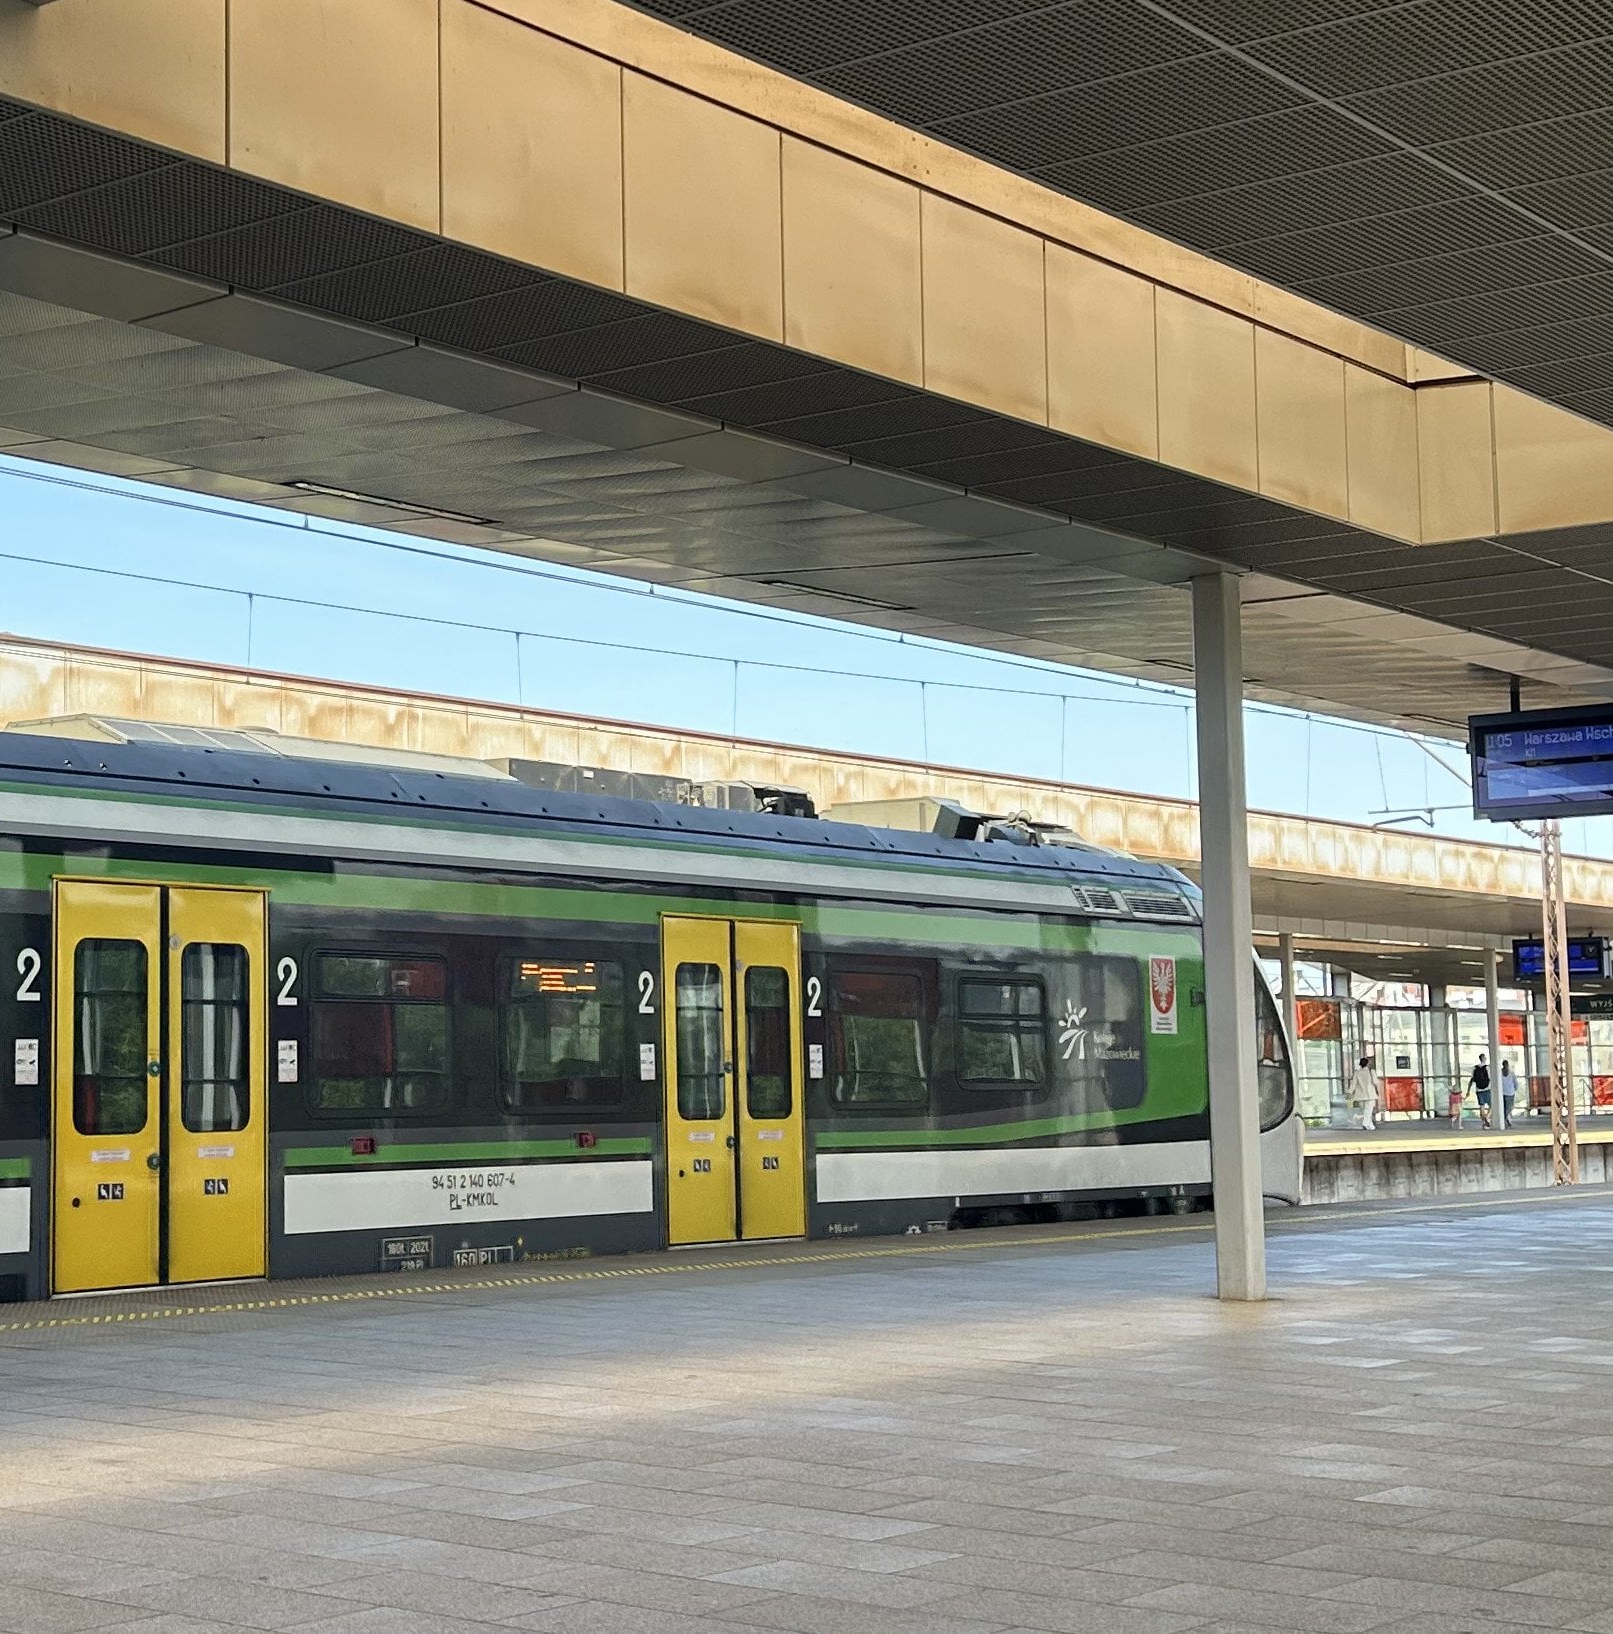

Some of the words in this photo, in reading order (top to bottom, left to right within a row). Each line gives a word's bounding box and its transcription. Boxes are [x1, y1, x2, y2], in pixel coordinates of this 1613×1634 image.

[1523, 730, 1583, 746] Warszawa
[16, 947, 41, 1001] 2
[277, 957, 298, 1005] 2
[638, 971, 654, 1014] 2
[807, 977, 821, 1016] 2
[432, 1175, 444, 1189] 94
[447, 1175, 457, 1189] 51
[460, 1175, 467, 1188] 2
[469, 1174, 484, 1188] 140
[487, 1172, 516, 1187] 607-4
